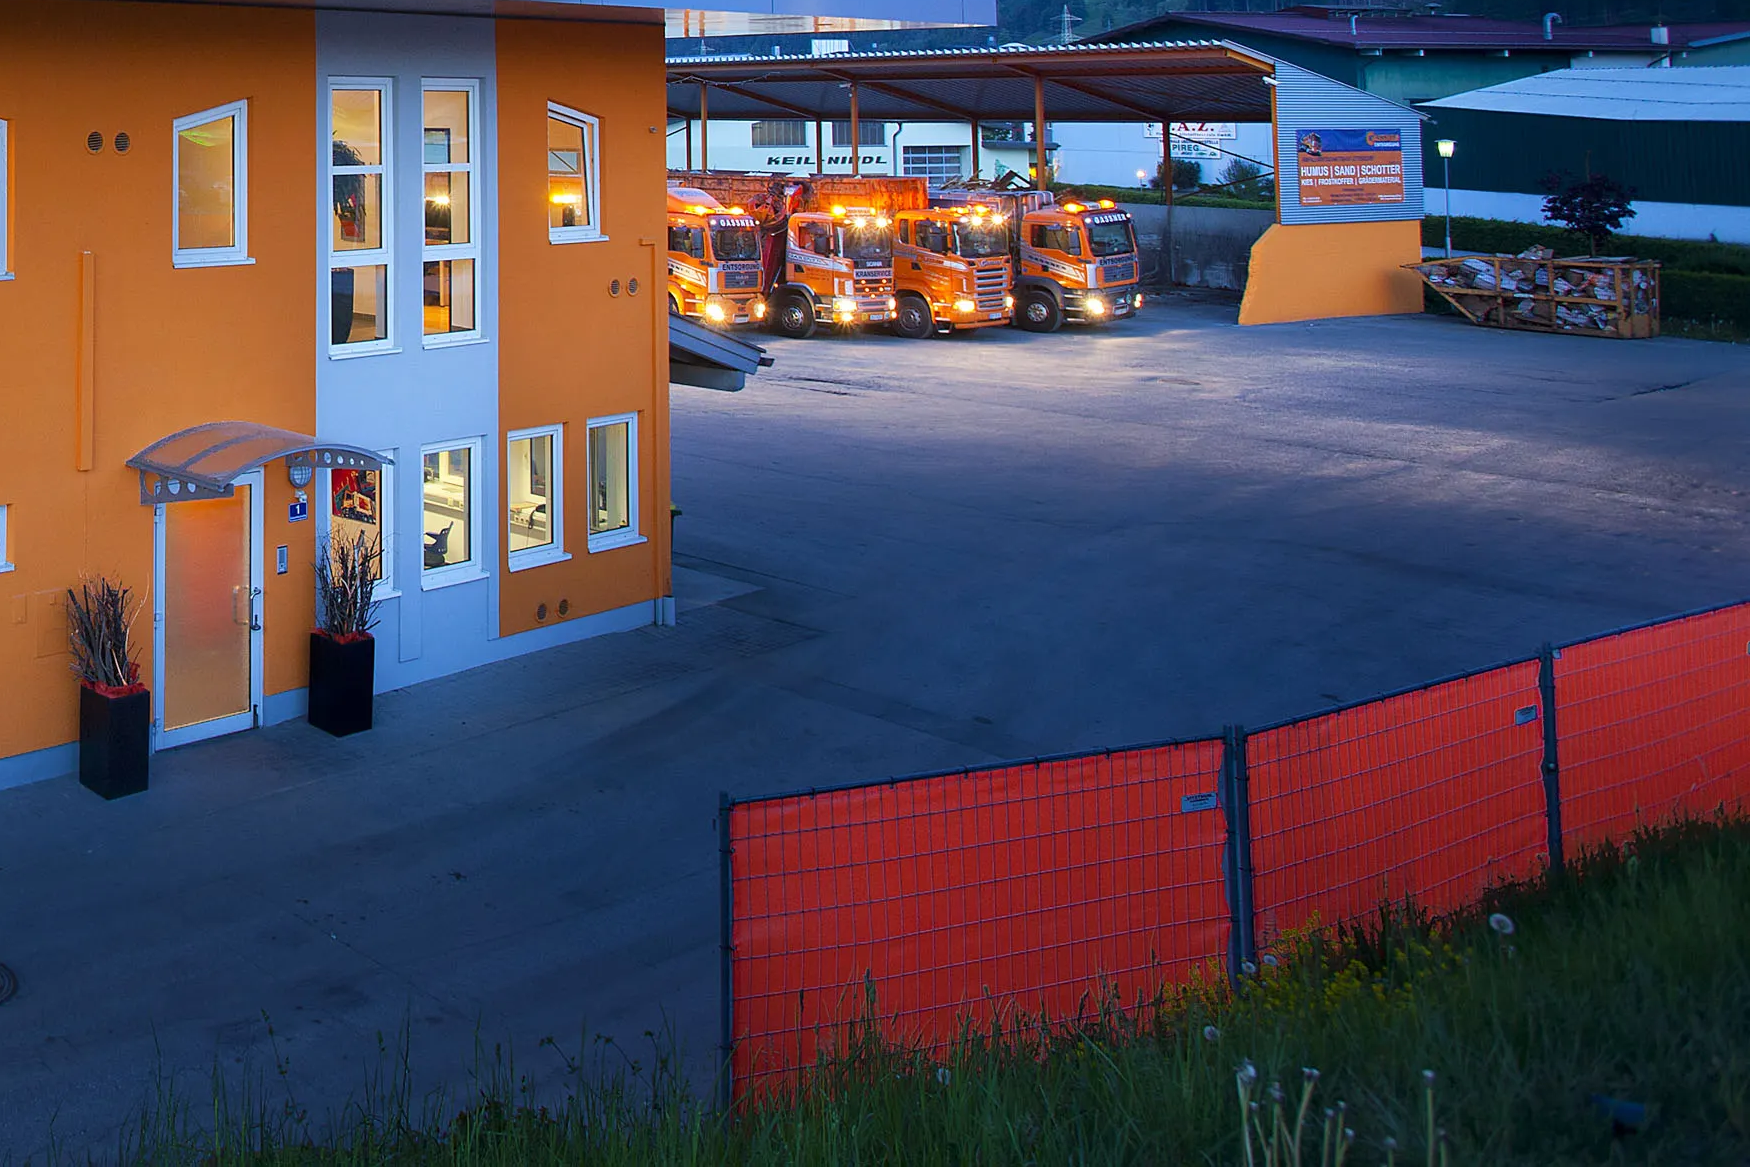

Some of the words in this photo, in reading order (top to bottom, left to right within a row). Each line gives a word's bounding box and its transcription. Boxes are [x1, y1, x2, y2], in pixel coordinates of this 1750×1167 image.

[1300, 166, 1329, 176] HUMUS
[1334, 165, 1356, 176] SAND
[1361, 164, 1401, 175] SCHOTTER
[722, 263, 761, 271] ENTSORGUNG
[855, 270, 892, 278] KRANSERVICE
[295, 505, 300, 514] 1
